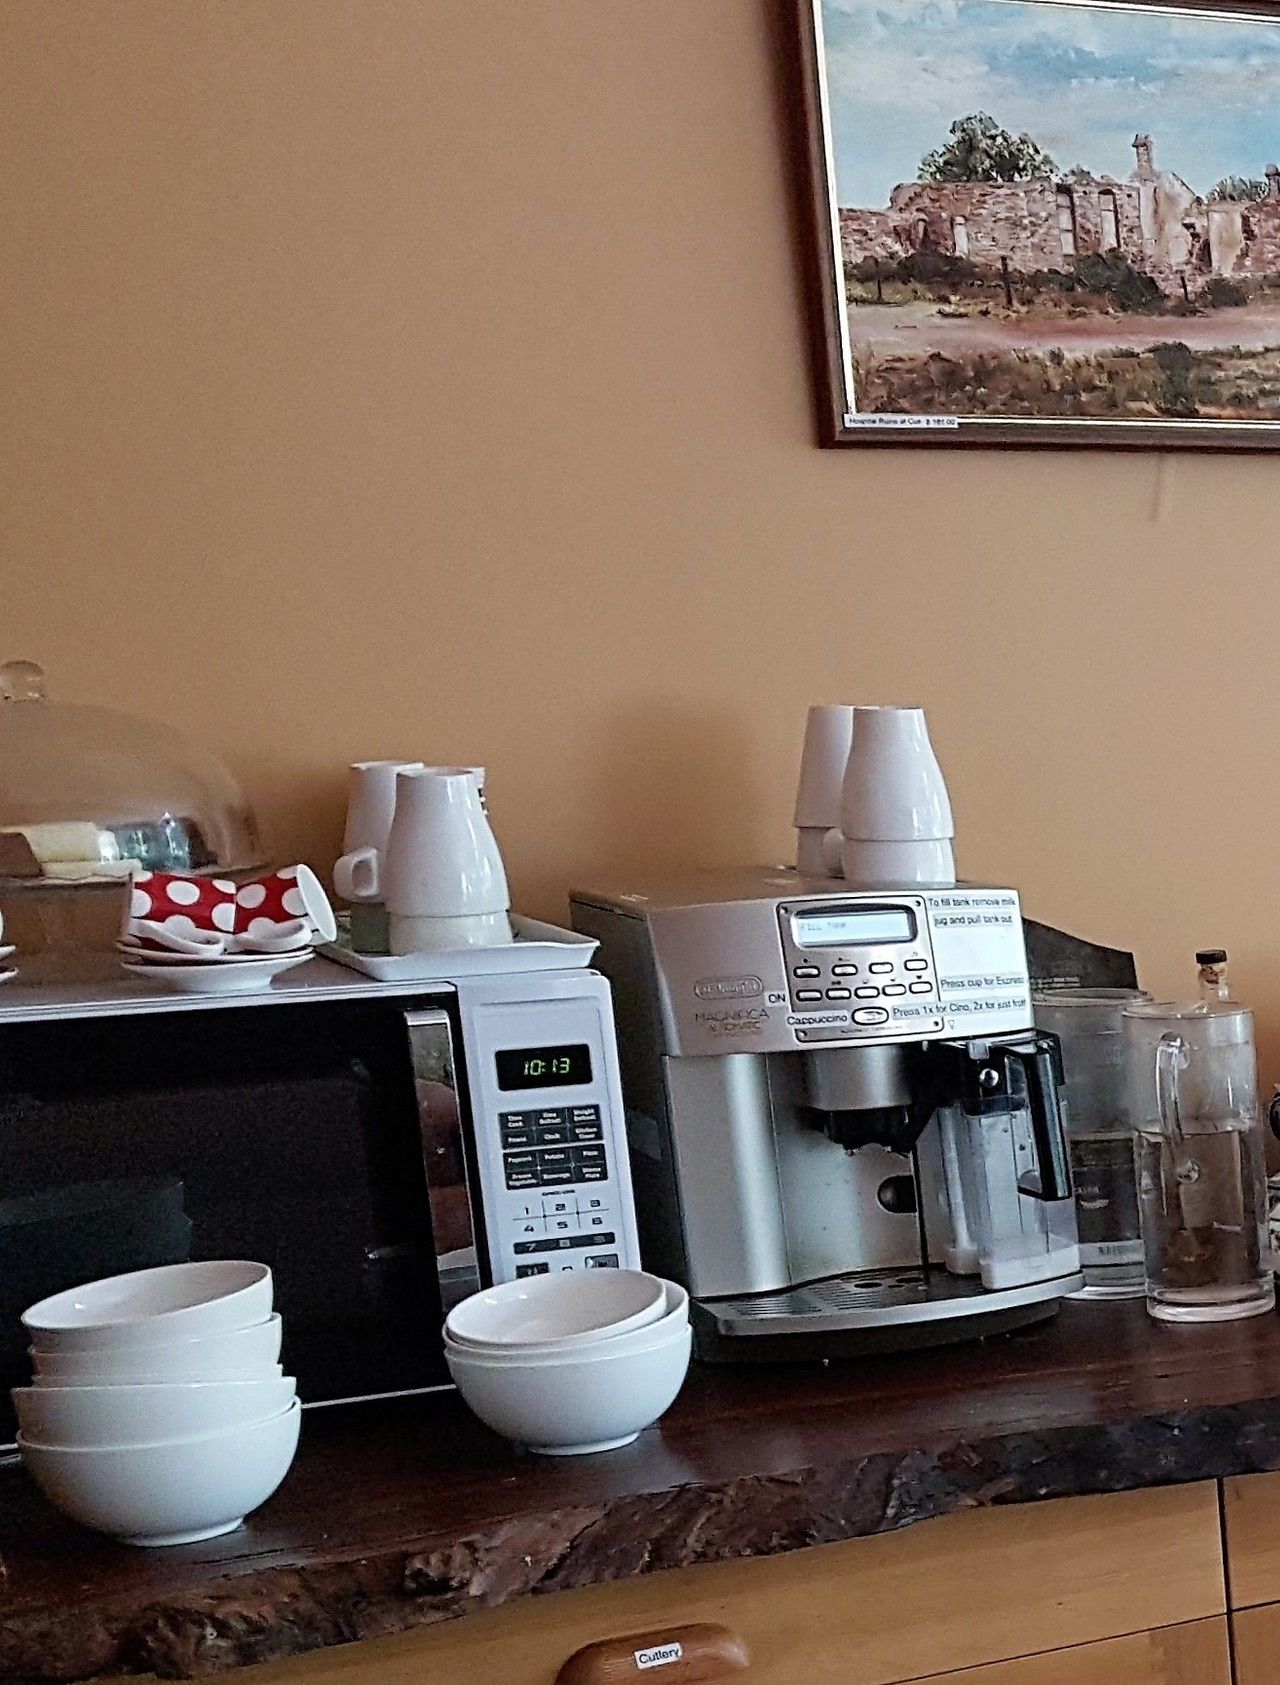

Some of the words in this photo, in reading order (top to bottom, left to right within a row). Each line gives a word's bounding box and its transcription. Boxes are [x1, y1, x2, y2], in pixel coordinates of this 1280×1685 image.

[949, 915, 965, 924] and
[967, 915, 981, 925] pull
[940, 979, 965, 989] Press
[967, 978, 983, 989] cup
[768, 992, 786, 1004] ON
[893, 1006, 921, 1017] Press
[923, 1005, 934, 1014] 1x
[935, 1003, 947, 1013] for
[973, 1001, 983, 1011] 2x
[985, 1000, 995, 1009] for
[786, 1013, 848, 1027] Cappuccino
[523, 1057, 571, 1076] 10:13
[555, 1203, 566, 1211] 2
[523, 1224, 534, 1232] 4
[556, 1221, 568, 1229] 5
[525, 1243, 536, 1252] 7
[638, 1647, 680, 1665] Cutlery
